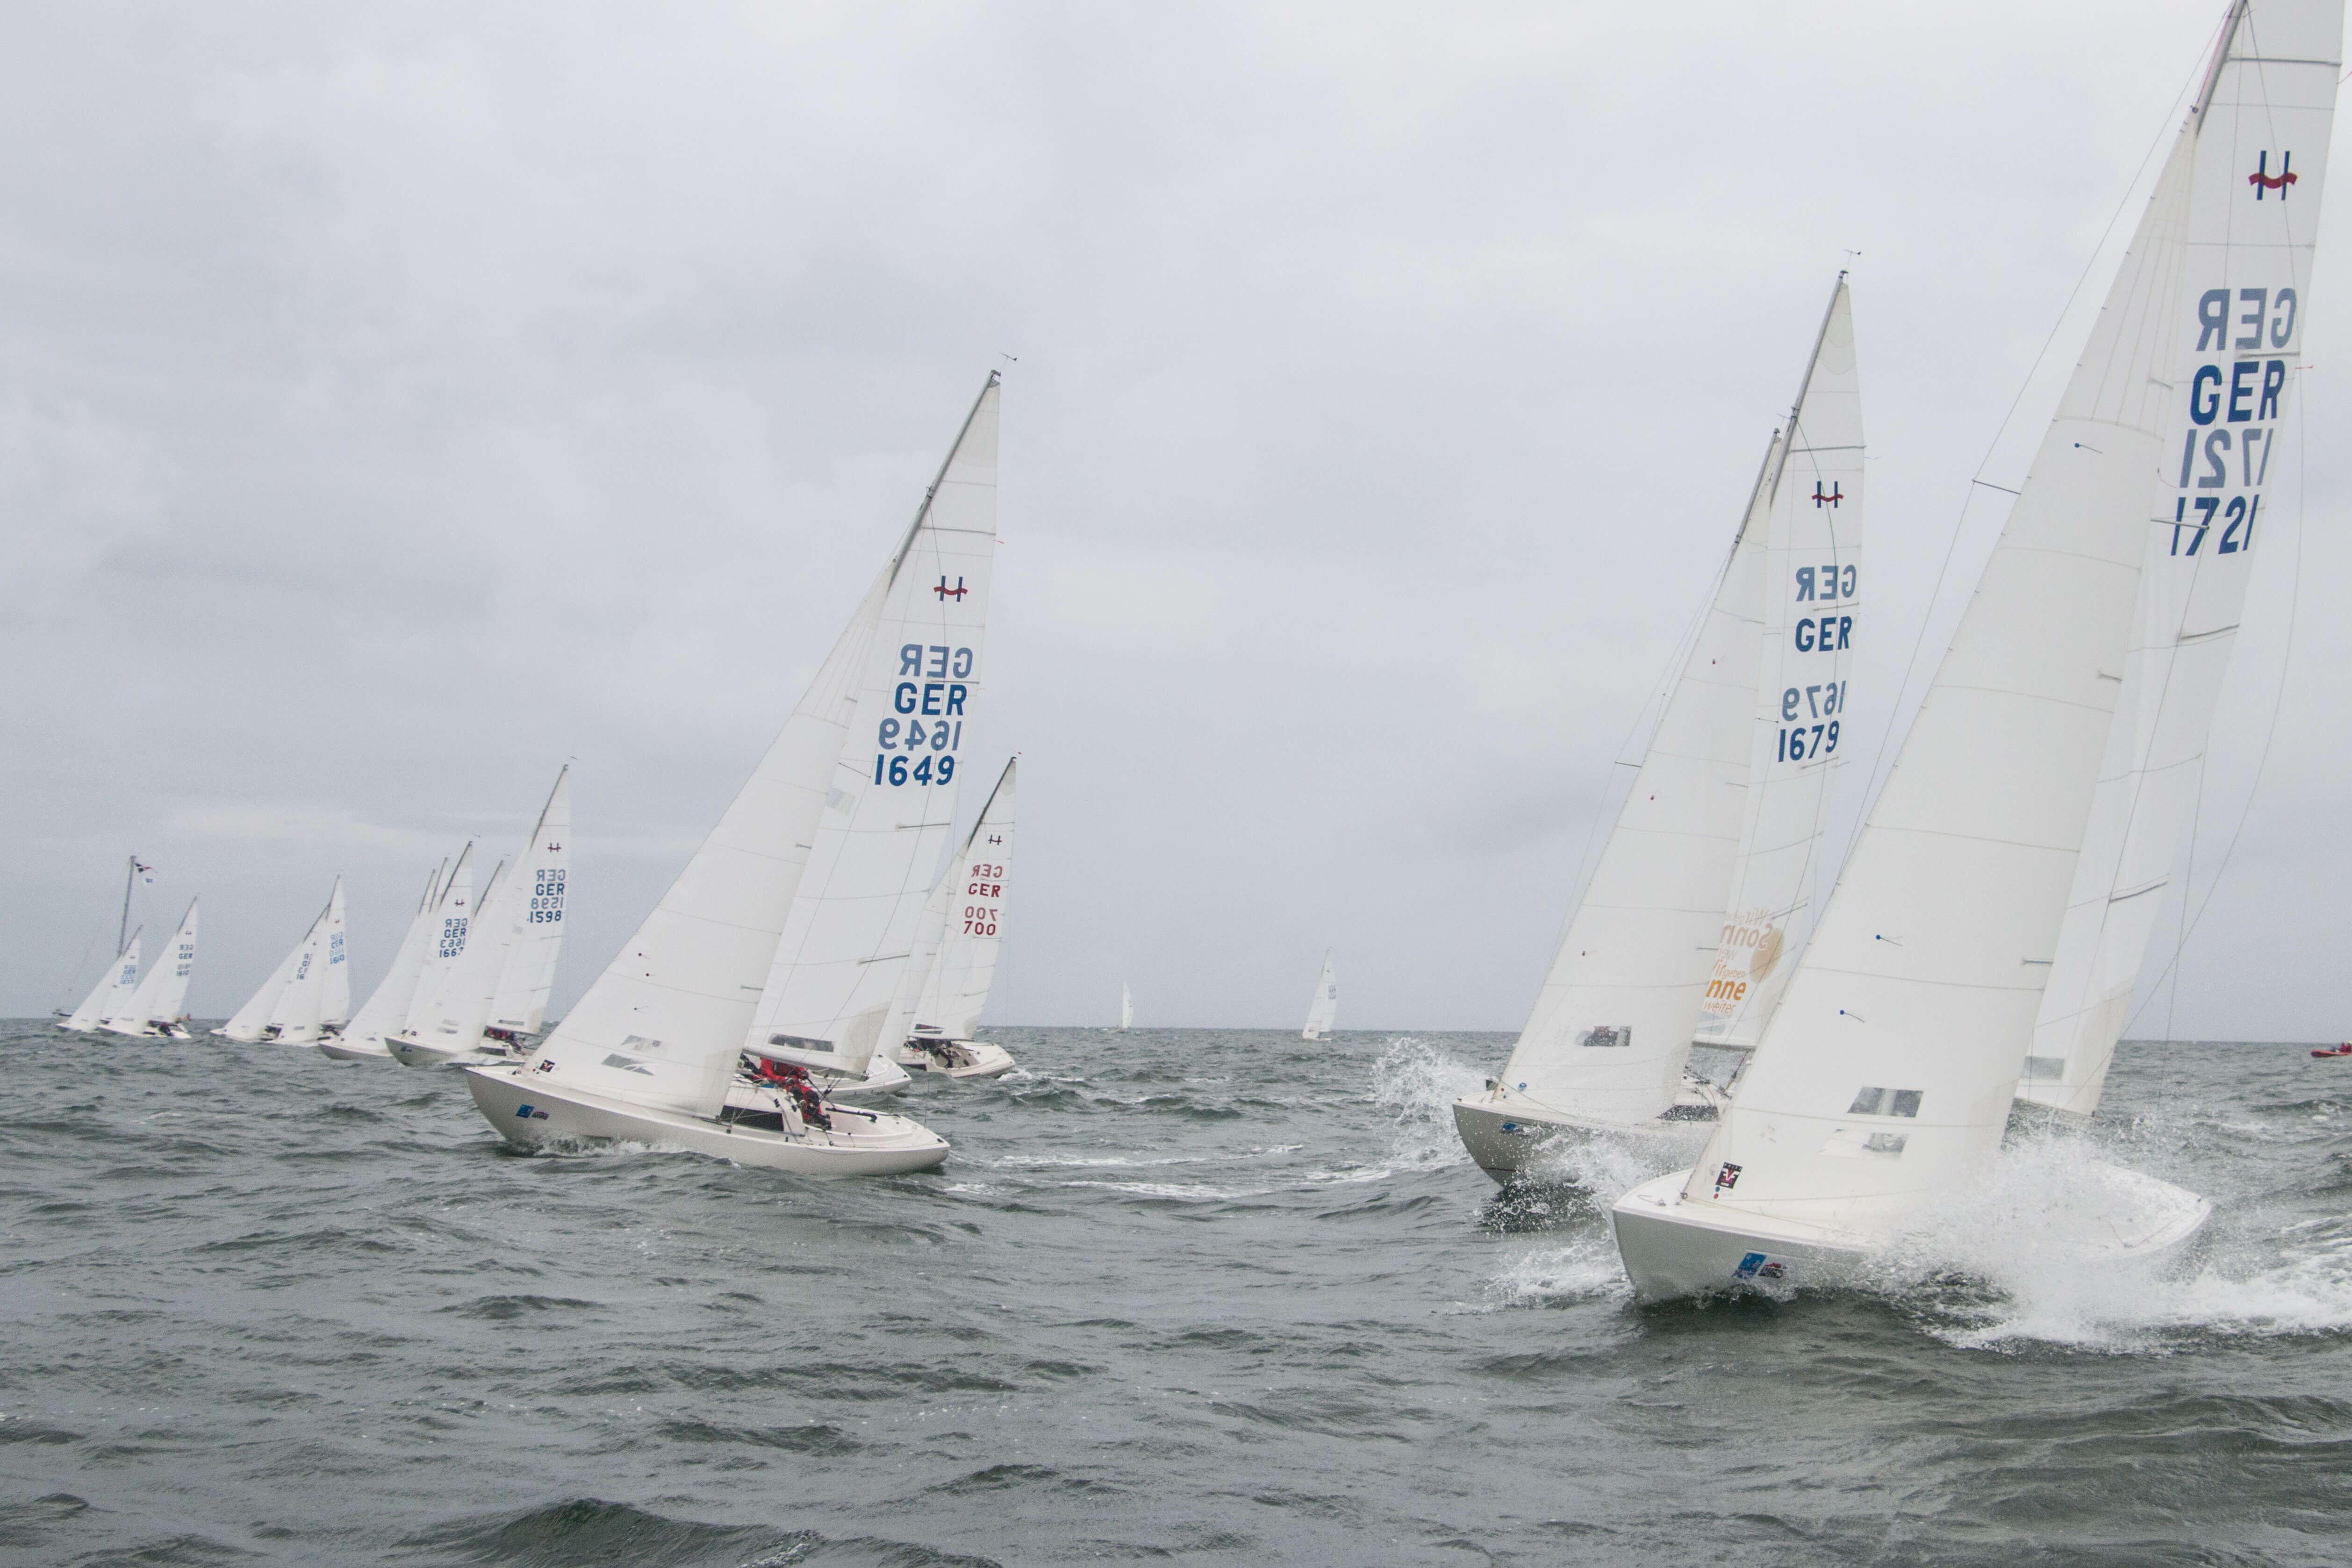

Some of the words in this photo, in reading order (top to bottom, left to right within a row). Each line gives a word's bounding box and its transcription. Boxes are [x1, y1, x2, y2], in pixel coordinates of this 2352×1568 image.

[2190, 360, 2285, 425] GER
[2171, 494, 2259, 556] 1721
[1795, 616, 1852, 652] GER
[894, 682, 967, 716] GER
[1778, 720, 1840, 762] 1679
[875, 754, 955, 786] 1649
[536, 883, 565, 896] GER
[968, 883, 1001, 898] GER
[530, 910, 562, 923] 1598
[964, 921, 996, 936] 700
[444, 928, 466, 938] GER
[1705, 980, 1747, 1001] nne
